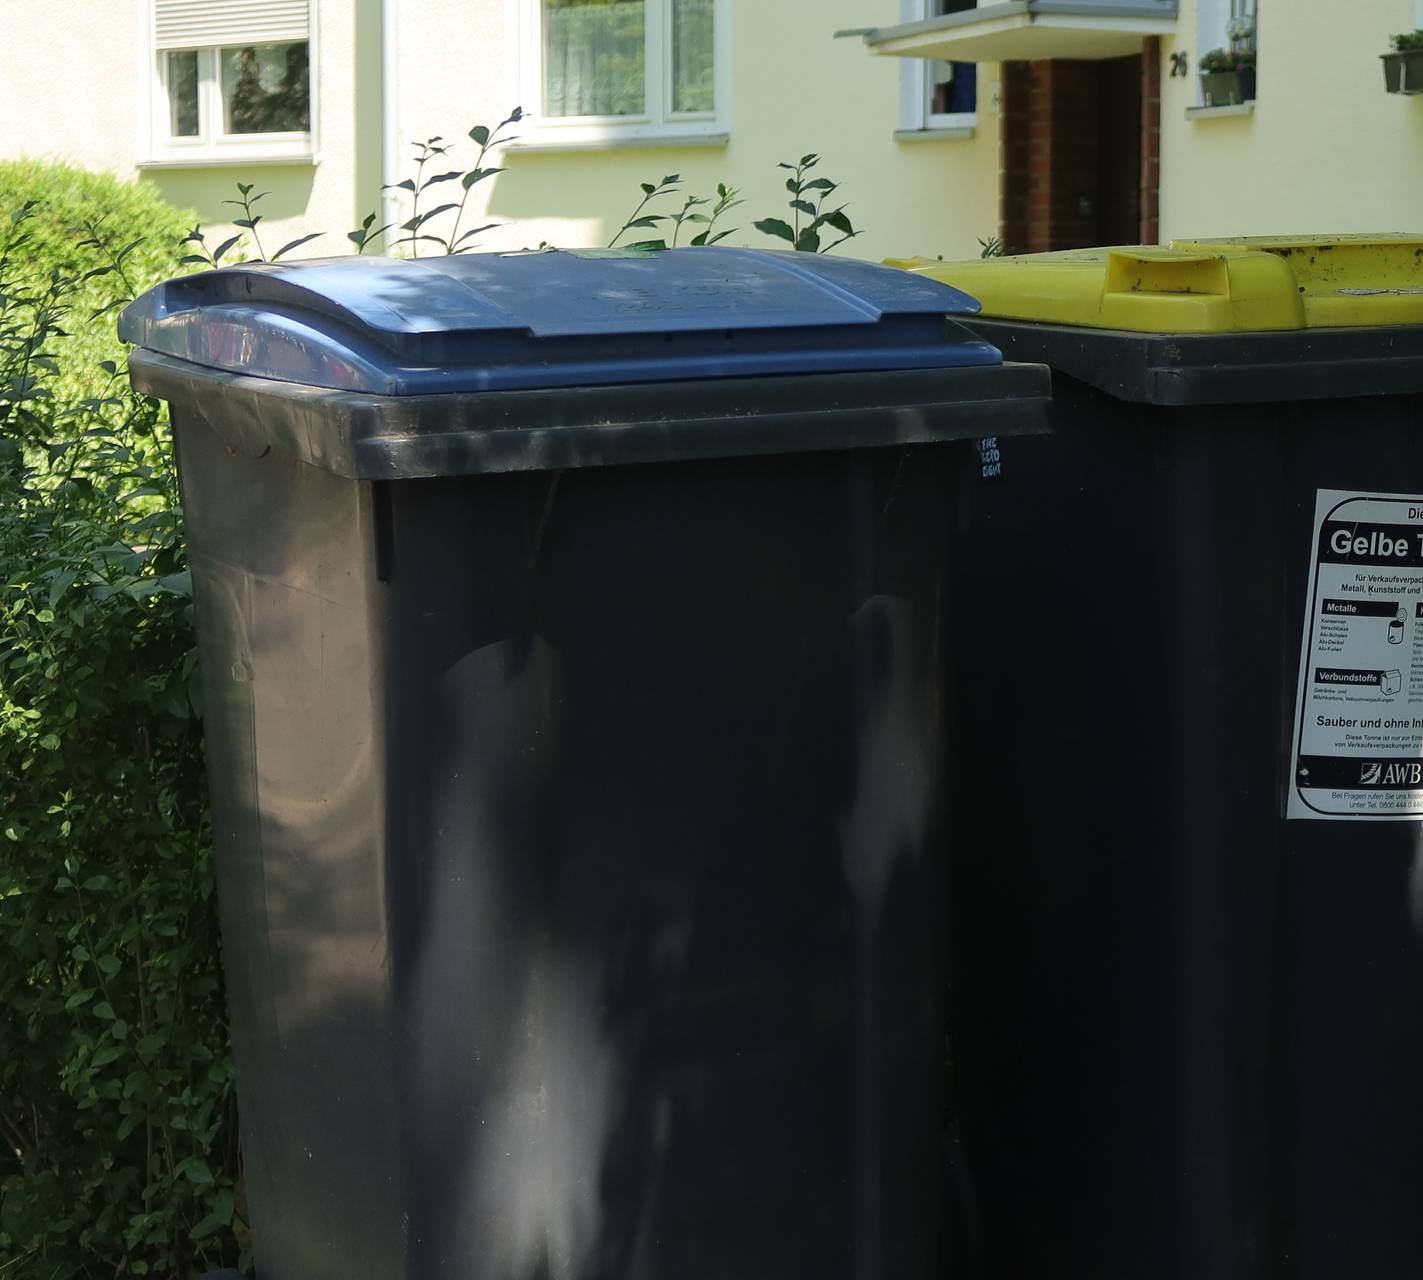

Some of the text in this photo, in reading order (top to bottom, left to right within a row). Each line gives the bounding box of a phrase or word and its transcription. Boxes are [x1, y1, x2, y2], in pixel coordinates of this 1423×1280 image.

[1330, 529, 1409, 557] Gelbe
[1355, 574, 1367, 582] für
[1341, 584, 1366, 593] Metall,
[1368, 585, 1406, 594] Kunststoff
[1407, 586, 1420, 594] und
[1326, 603, 1357, 613] Metalle
[1319, 672, 1378, 683] Verbundstoffe
[1316, 716, 1357, 728] Sauber
[1360, 717, 1381, 728] und
[1384, 717, 1409, 728] ohne
[1347, 741, 1412, 749] Verkaufsverpackungen
[1382, 763, 1422, 784] AWB
[1343, 792, 1366, 801] Fragen
[1367, 792, 1384, 800] rufen
